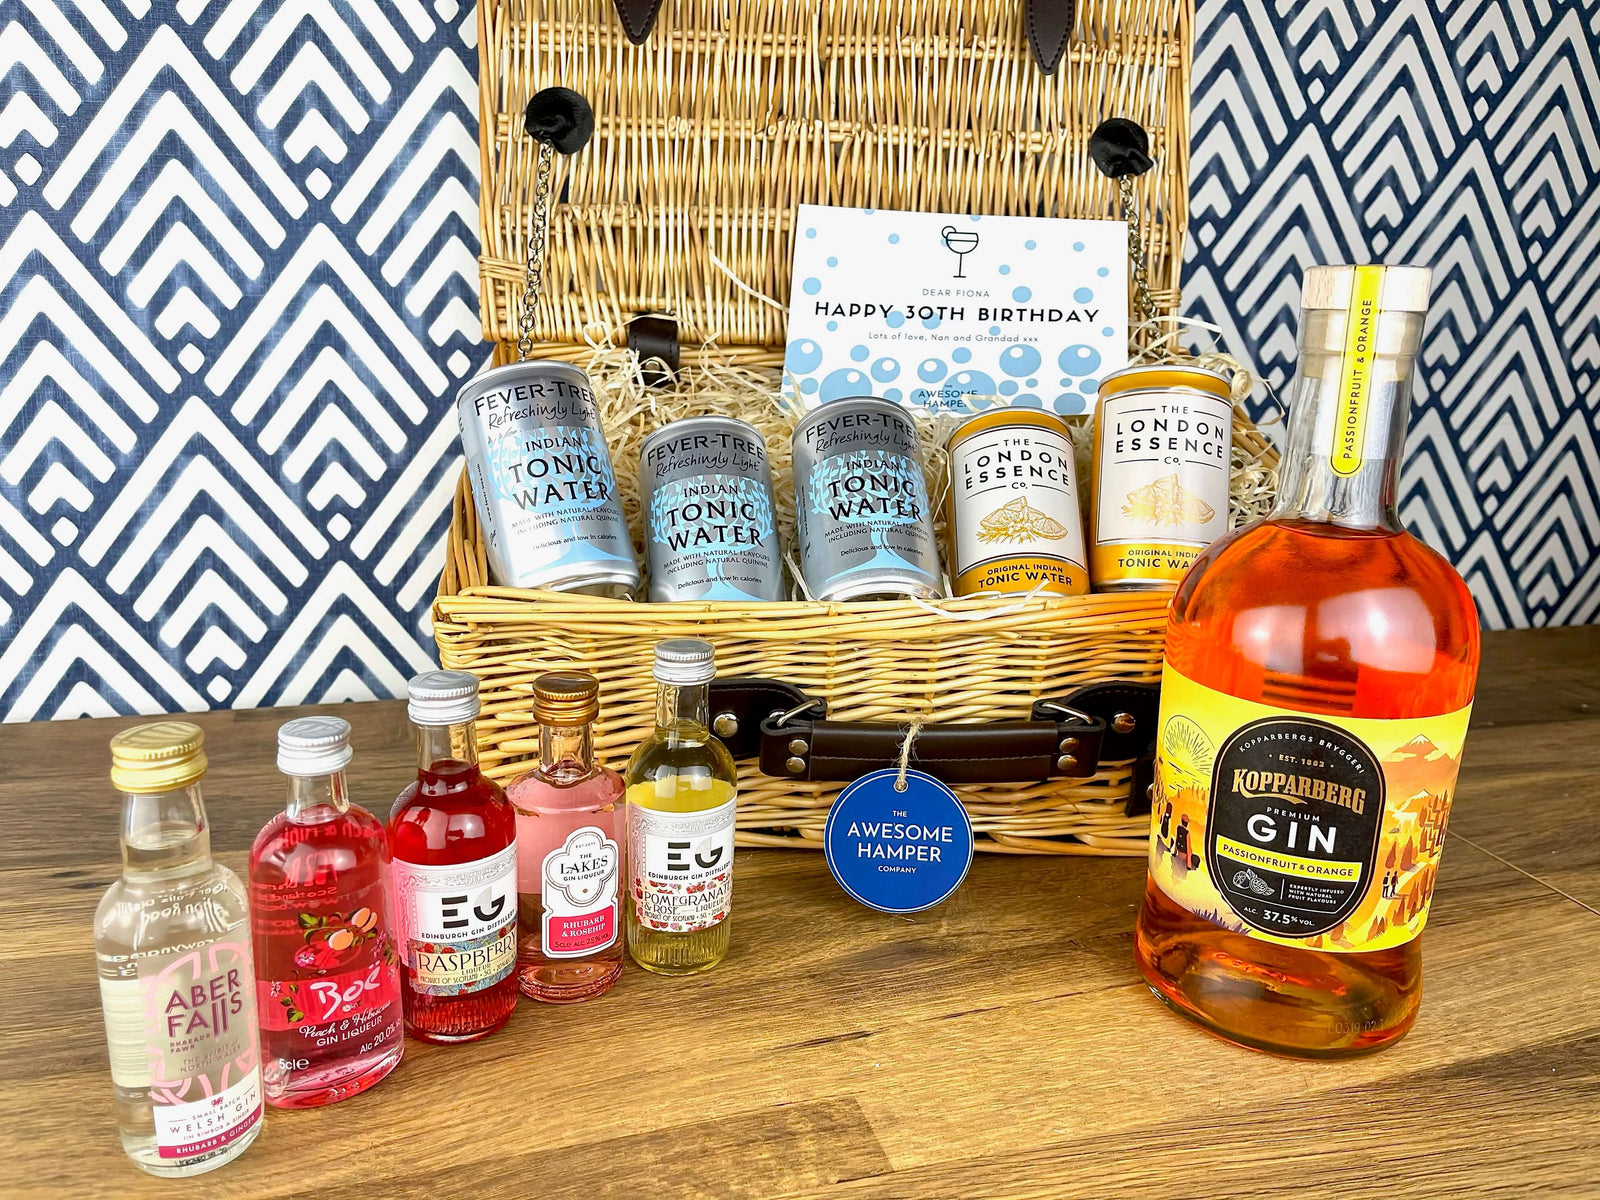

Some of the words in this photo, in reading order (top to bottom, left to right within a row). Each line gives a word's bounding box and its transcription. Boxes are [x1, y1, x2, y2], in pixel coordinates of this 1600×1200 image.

[922, 288, 952, 297] DEAR
[956, 289, 991, 298] FIONA
[815, 301, 894, 320] HAPPY
[906, 304, 965, 321] 30TH
[979, 307, 1099, 323] BIRTHDAY
[868, 331, 887, 340] Lots
[890, 331, 901, 340] of
[904, 332, 928, 342] love,
[931, 333, 950, 342] Nan
[954, 333, 971, 342] and
[975, 334, 1019, 343] Grandad
[1343, 369, 1364, 459] PASSIONFRUIT
[1356, 300, 1372, 353] ORANGE
[474, 381, 597, 416] FEVER-TREE
[923, 399, 967, 408] HAMPE
[489, 401, 568, 429] Refreshingly
[572, 404, 596, 421] Light
[1162, 405, 1188, 415] THE
[805, 413, 920, 444] FEVER-TREE
[1117, 418, 1224, 441] LONDON
[526, 437, 582, 452] INDIAN
[647, 433, 765, 466] FEVER-TREE
[816, 430, 890, 454] Refreshingly
[894, 435, 916, 453] Light
[1003, 438, 1030, 447] THE
[1115, 437, 1223, 459] ESSENCE
[508, 455, 602, 483] TONIC
[656, 451, 728, 478] Refreshingly
[733, 453, 760, 472] Light
[846, 460, 900, 471] INDIAN
[964, 449, 1068, 475] LONDON
[827, 475, 916, 499] TONIC
[965, 465, 1070, 490] ESSENCE
[513, 480, 613, 510] WATER
[684, 484, 738, 497] INDIAN
[534, 511, 554, 521] WITH
[556, 507, 592, 517] NATURAL
[560, 515, 595, 523] NATURAL
[666, 501, 755, 527] TONIC
[829, 497, 924, 523] WATER
[667, 525, 764, 552] WATER
[824, 526, 844, 538] MADE
[846, 521, 865, 530] WITH
[828, 527, 868, 543] INCLUDING
[663, 557, 681, 569] MADE
[683, 553, 701, 561] WITH
[704, 549, 737, 557] NATURAL
[840, 545, 869, 556] Delicious
[1128, 549, 1172, 557] ORIGINAL
[667, 560, 704, 575] INCLUDING
[706, 556, 740, 564] NATURAL
[987, 563, 1030, 576] ORIGINAL
[1033, 563, 1064, 573] INDIAN
[1118, 558, 1160, 569] TONIC
[678, 579, 704, 589] Delicious
[740, 576, 762, 584] calories
[978, 572, 1020, 589] TONIC
[1025, 571, 1073, 587] WATER
[1238, 733, 1314, 753] KOPPARBERGS
[1318, 739, 1366, 774] BRYGGERI
[1278, 754, 1298, 764] EST.
[1231, 768, 1366, 815] KOPPARBERG
[1266, 806, 1320, 822] PREMIUM
[847, 821, 953, 842] AWESOME
[1246, 813, 1337, 855] GIN
[668, 837, 723, 871] EG
[857, 842, 942, 863] HAMPER
[1222, 843, 1298, 871] PASSIONFRUIT
[1307, 865, 1354, 877] ORANGE
[560, 855, 608, 875] LAKES
[577, 869, 605, 881] LIQUEUR
[648, 872, 688, 880] EDINBURGH
[705, 861, 731, 877] DISTILLERY
[877, 865, 917, 874] COMPANY
[1289, 883, 1319, 892] EXPERTLY
[441, 886, 506, 929] EG
[696, 897, 724, 912] LIQUEUR
[1307, 897, 1337, 905] FLAVOURS
[421, 932, 468, 940] EDINBURGH
[487, 909, 515, 930] DISTILLERY
[563, 915, 605, 929] RHUBARB
[1243, 906, 1258, 915] ALC.
[1262, 909, 1298, 925] 37.5%
[1299, 918, 1315, 927] VOL.
[570, 923, 605, 937] ROSEHIP
[419, 932, 516, 973] RASPBERRY
[165, 969, 242, 1014] ABER
[299, 1022, 336, 1038] Peach
[340, 1019, 350, 1031] &
[317, 1035, 338, 1046] GIN
[342, 1015, 382, 1040] LIQUEUR
[359, 1041, 373, 1055] Alc
[374, 1024, 396, 1046] 20.0%
[180, 1060, 212, 1073] NORTH
[217, 1045, 241, 1061] WALES
[183, 1056, 200, 1065] THE
[169, 1113, 225, 1134] WELSH
[235, 1091, 256, 1112] GIN
[192, 1109, 217, 1120] SMALL
[219, 1096, 241, 1110] BATCH
[176, 1140, 217, 1154] RHUBARB
[229, 1114, 255, 1137] GINGER
